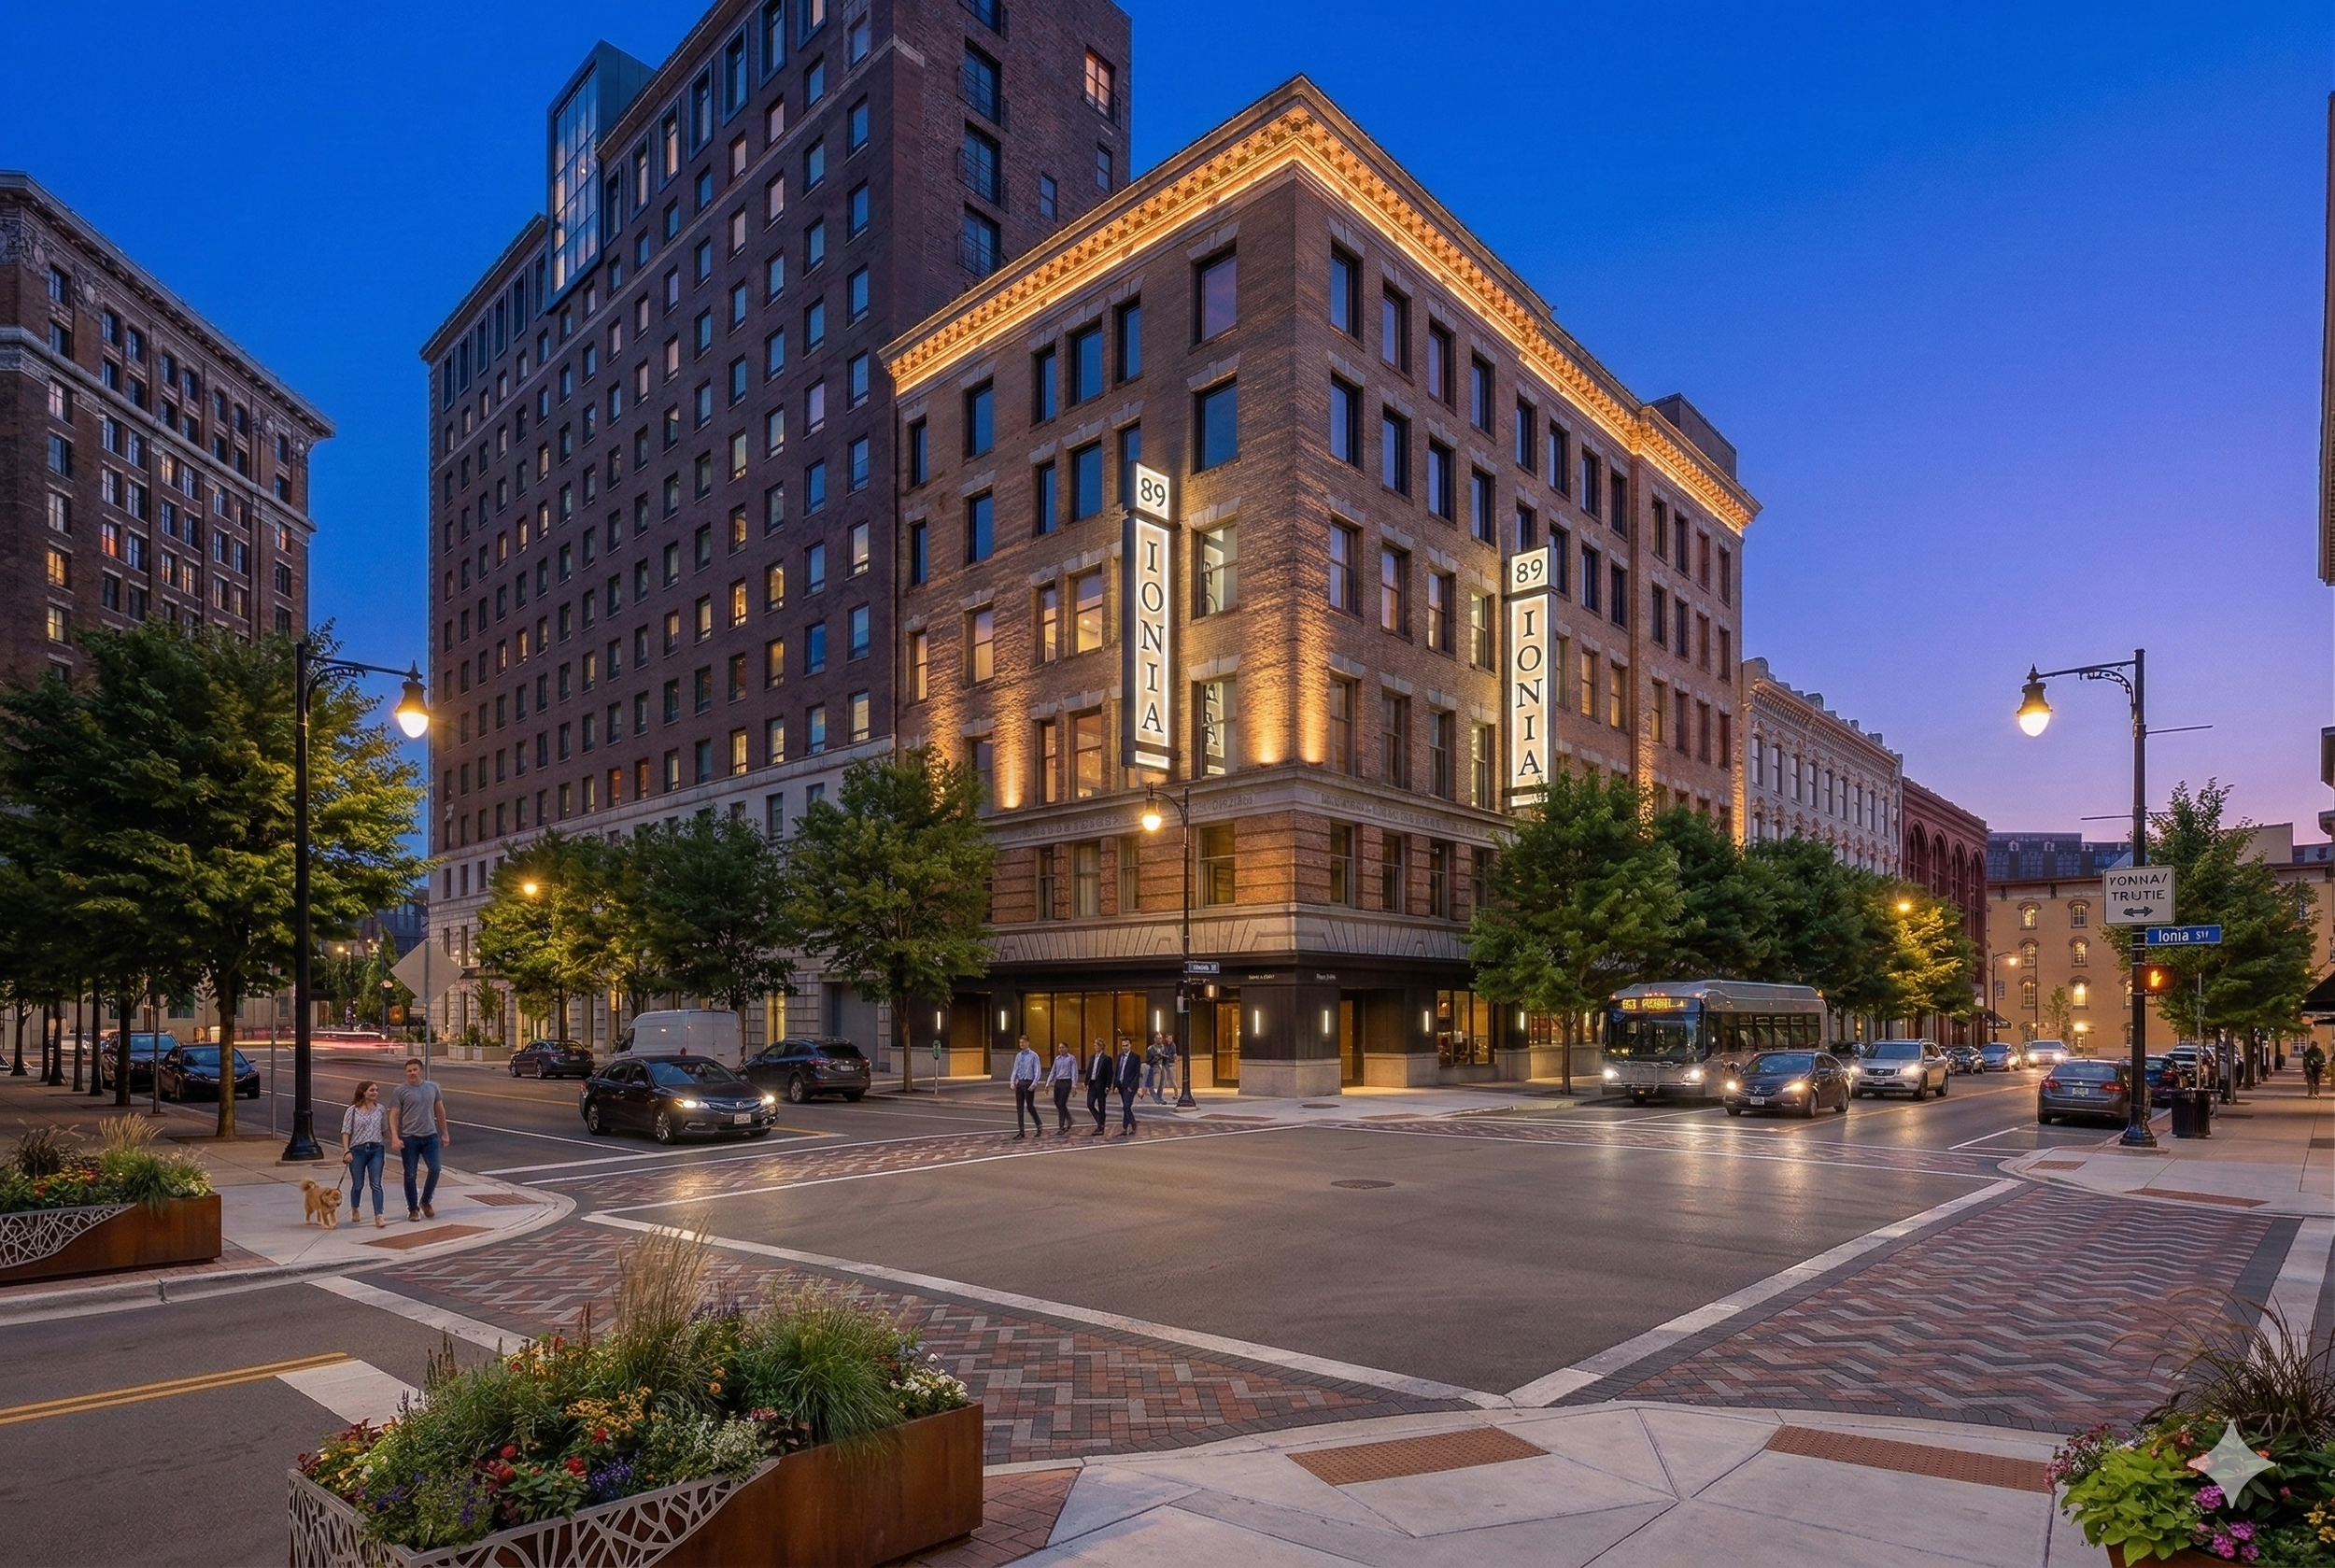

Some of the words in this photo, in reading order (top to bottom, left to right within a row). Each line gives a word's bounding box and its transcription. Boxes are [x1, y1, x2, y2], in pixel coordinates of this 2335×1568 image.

[1140, 478, 1166, 507] 89
[1516, 558, 1543, 584] 89
[1141, 541, 1164, 734] IONIA
[1516, 610, 1543, 777] IONIA
[2158, 929, 2189, 942] Ionia
